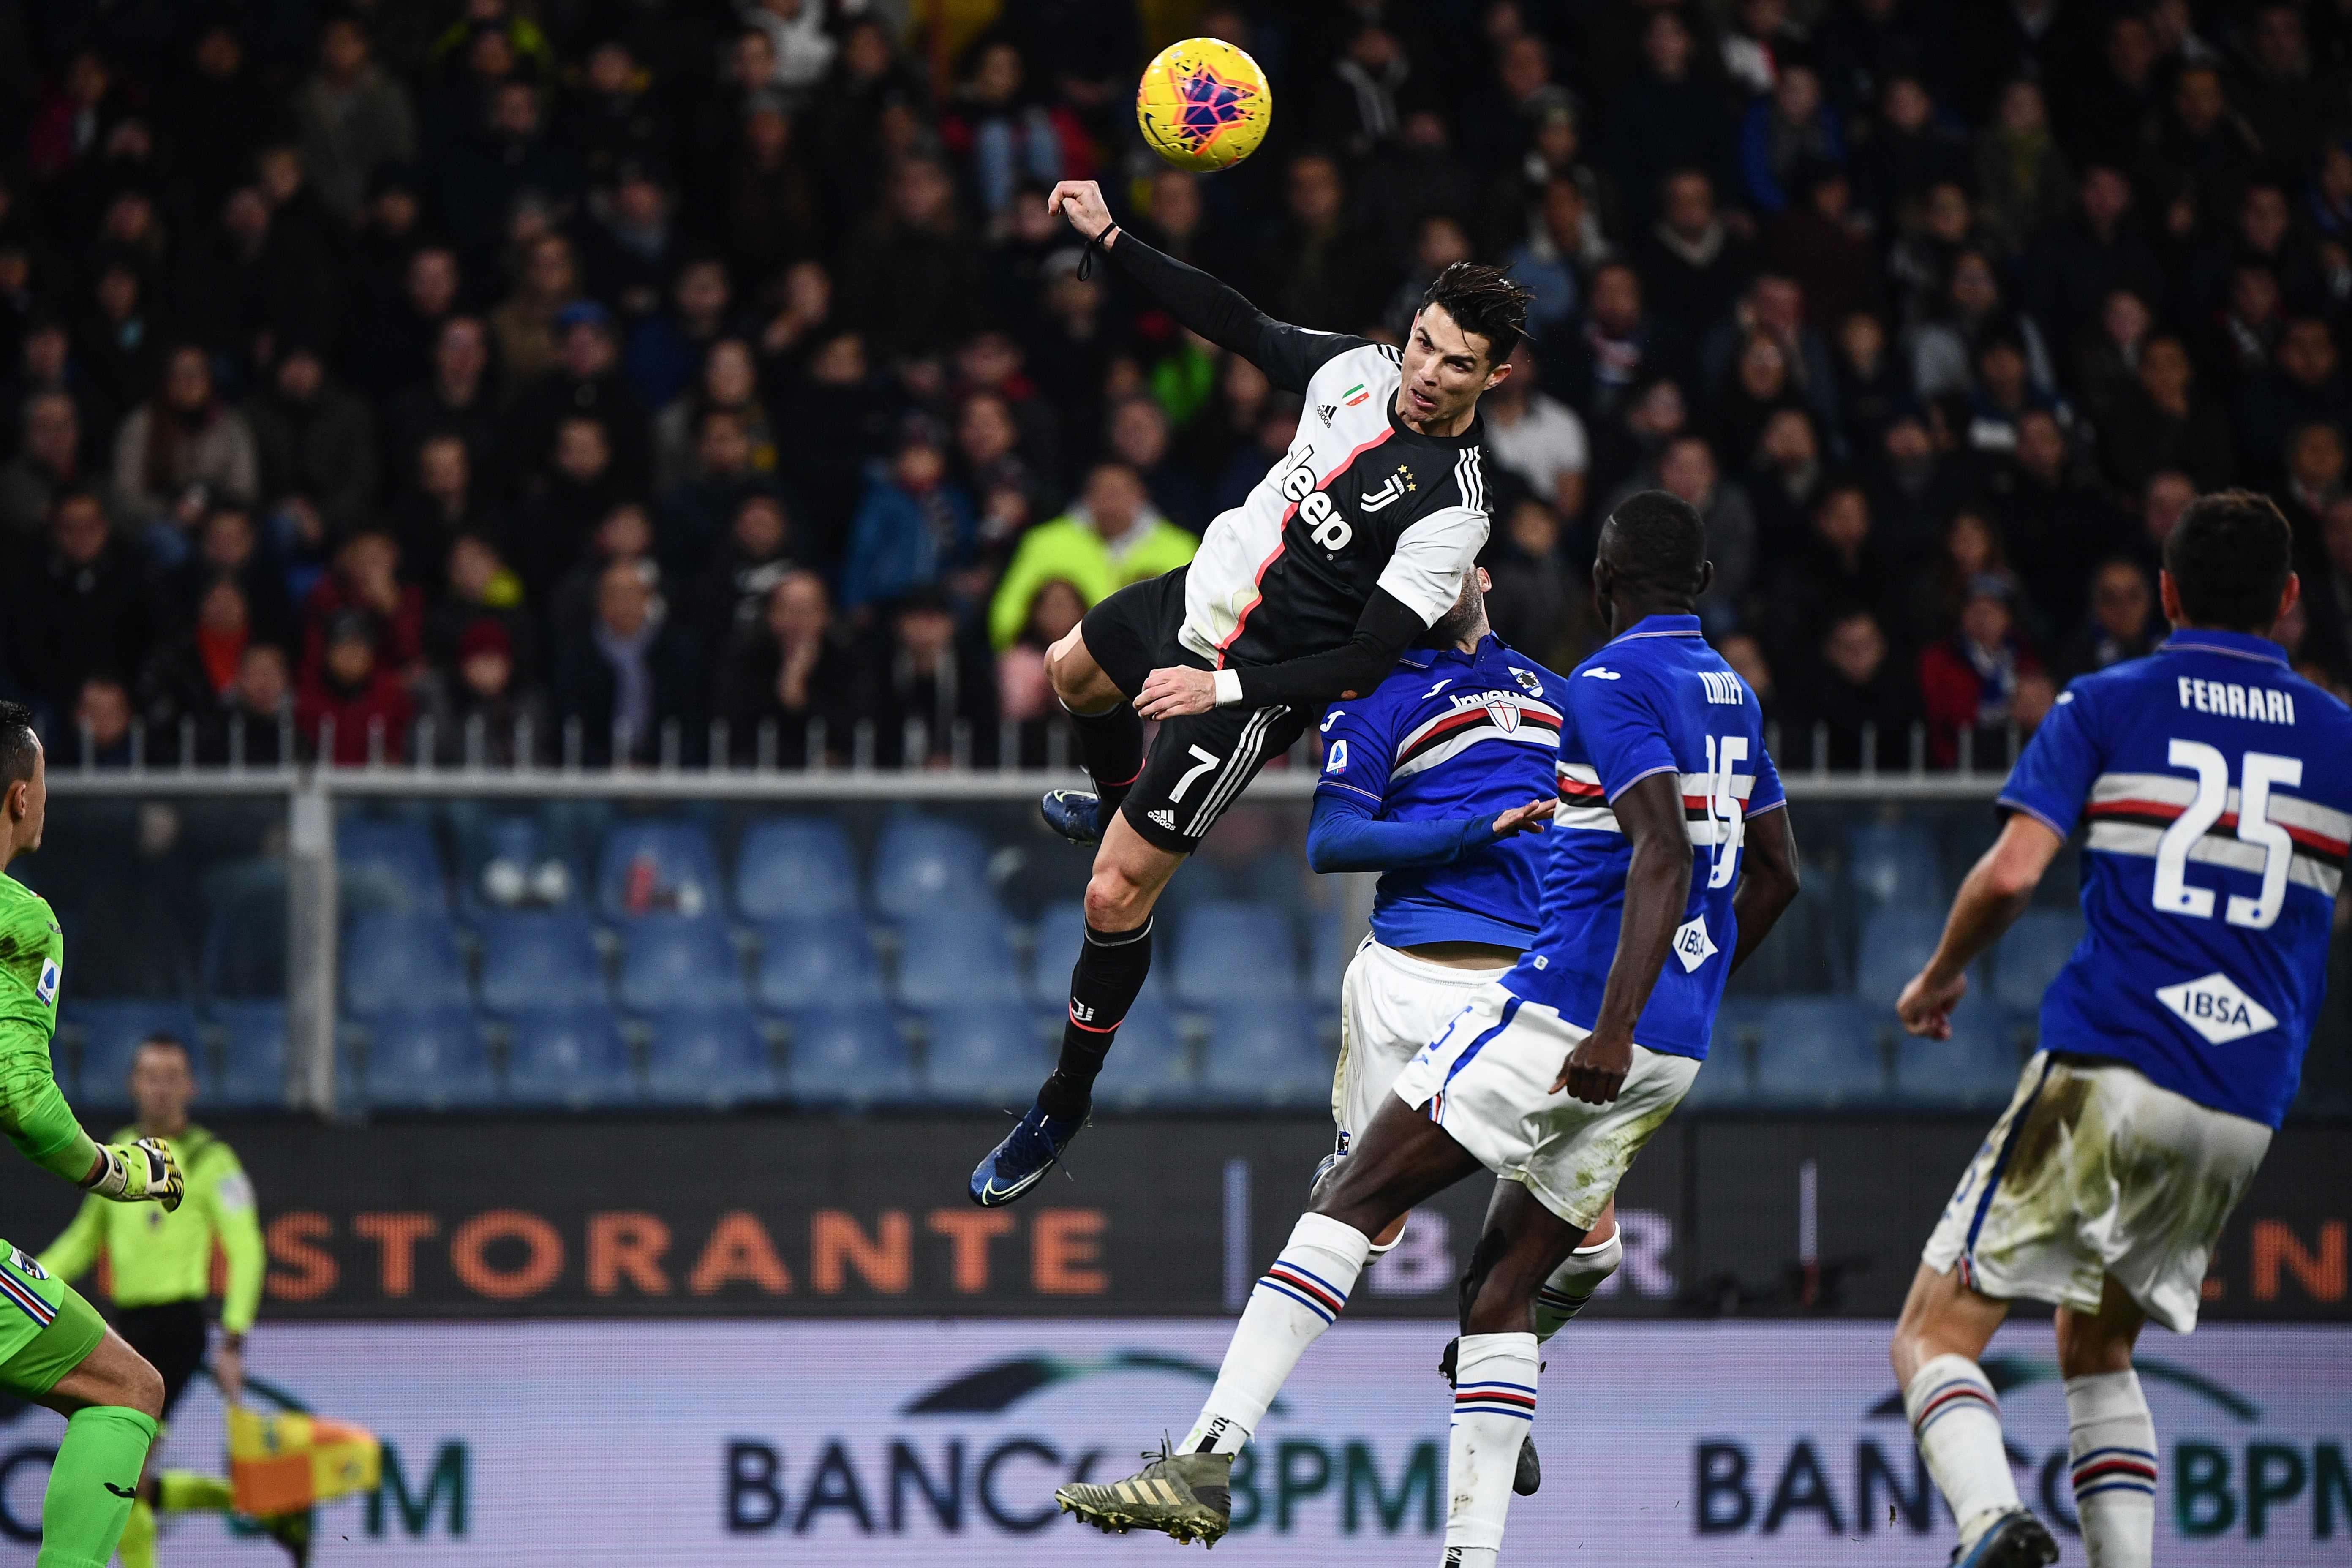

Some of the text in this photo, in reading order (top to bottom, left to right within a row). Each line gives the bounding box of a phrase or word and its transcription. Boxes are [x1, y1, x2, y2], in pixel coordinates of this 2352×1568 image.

[1317, 406, 1332, 428] adidas
[1282, 444, 1352, 550] Jeep
[2177, 675, 2295, 727] FERRARI
[1168, 743, 1220, 803] 7
[1147, 811, 1176, 831] adidas
[1705, 735, 1748, 889] 15
[2152, 738, 2303, 929] 25
[1679, 928, 1705, 958] IBSA
[2184, 990, 2251, 1031] IBSA
[1368, 1208, 1678, 1298] BR
